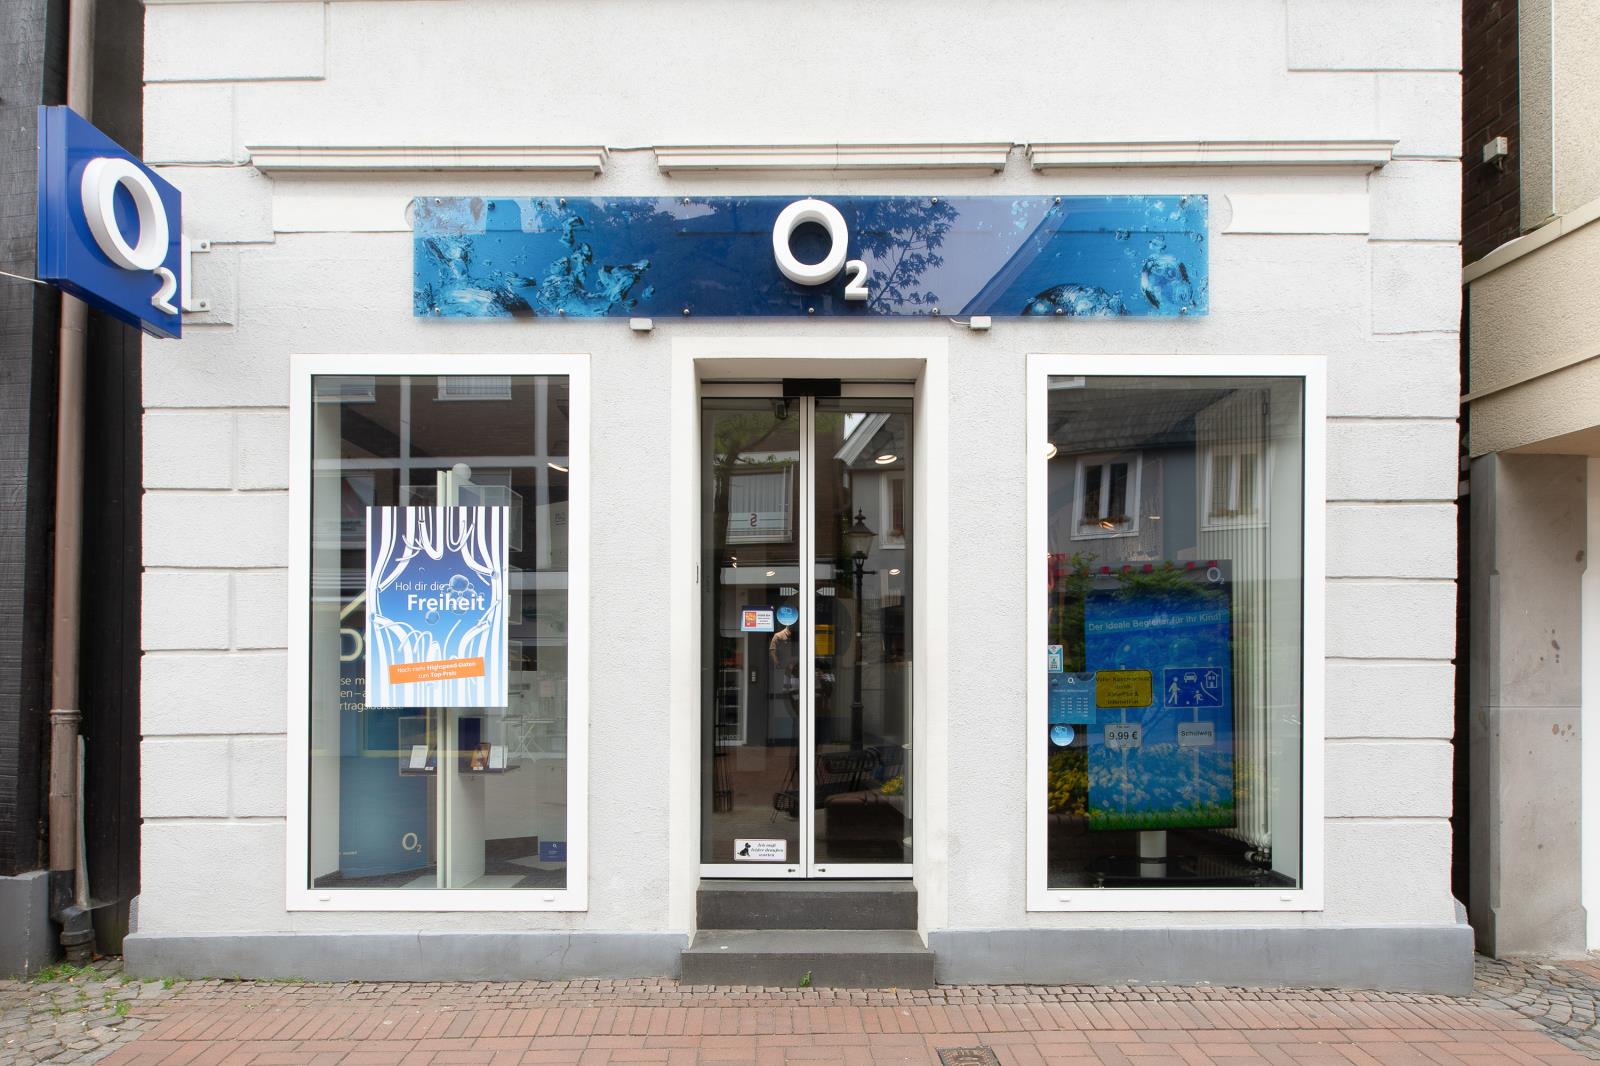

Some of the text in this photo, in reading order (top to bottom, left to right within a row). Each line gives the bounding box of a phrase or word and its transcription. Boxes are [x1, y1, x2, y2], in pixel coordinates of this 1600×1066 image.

[81, 157, 178, 314] O2
[773, 199, 868, 300] O2
[395, 582, 444, 591] Hol dir die
[407, 593, 485, 611] Freiheit
[1088, 623, 1103, 631] Der
[402, 832, 422, 853] O2
